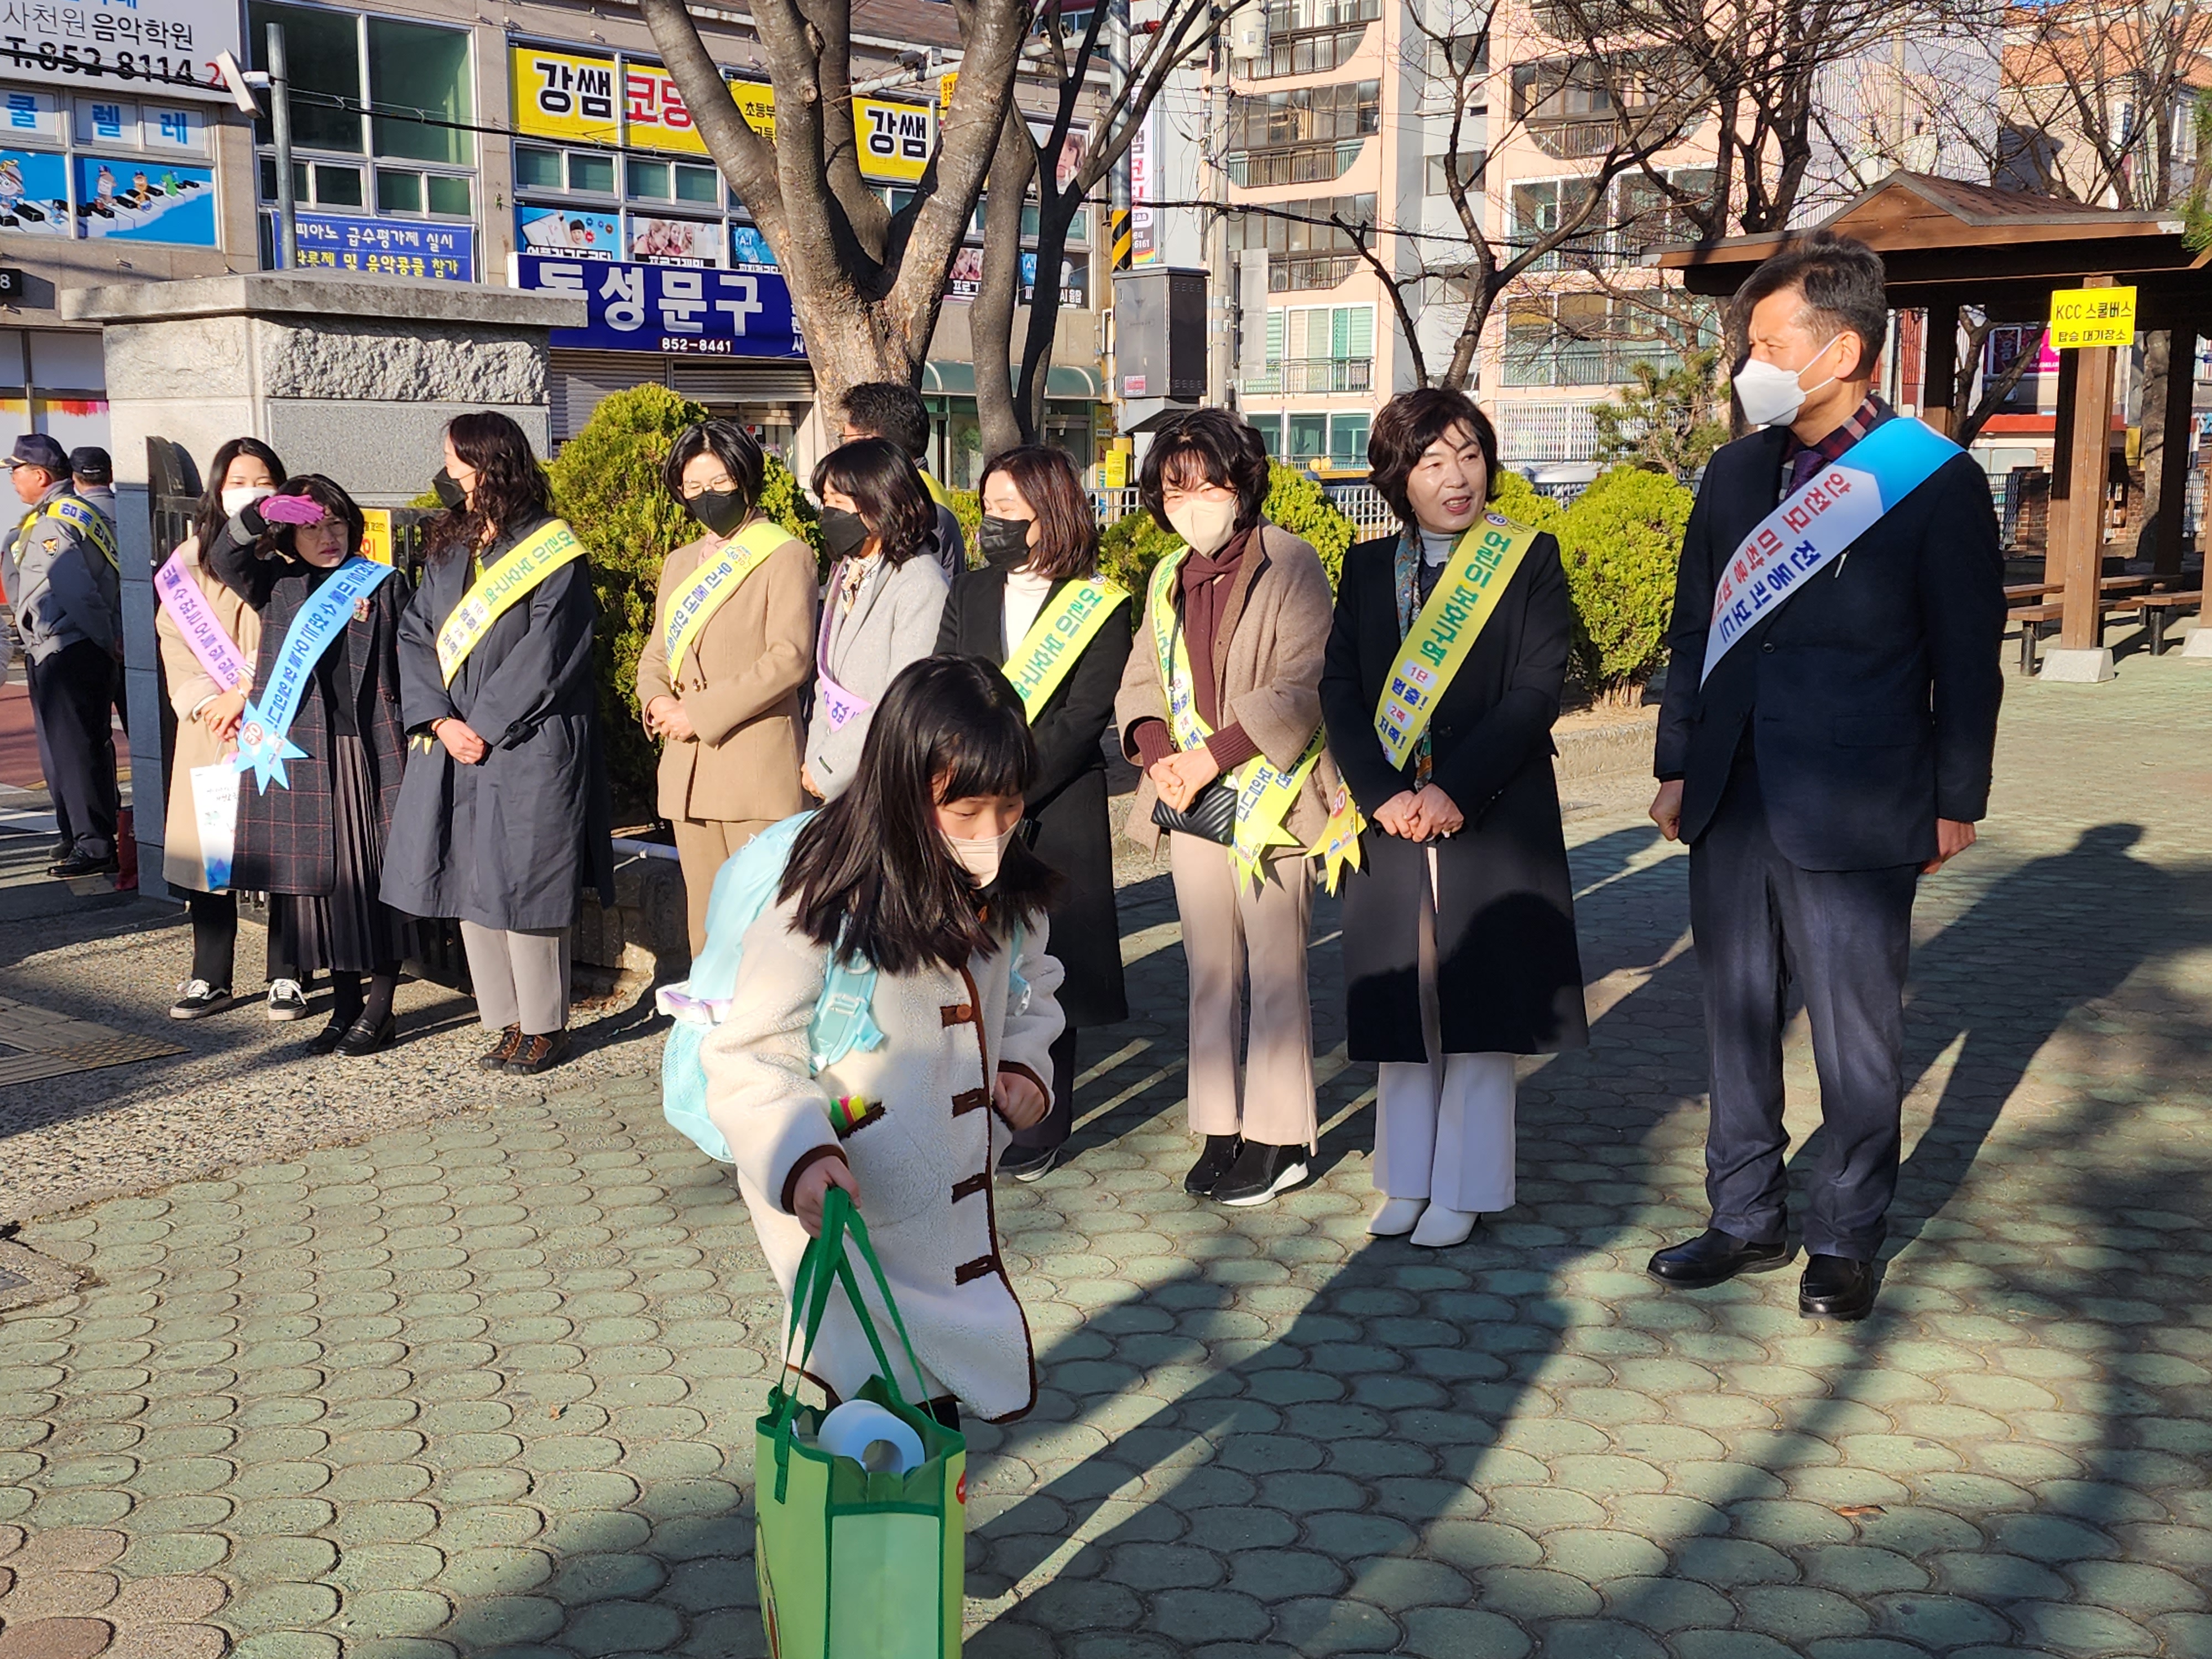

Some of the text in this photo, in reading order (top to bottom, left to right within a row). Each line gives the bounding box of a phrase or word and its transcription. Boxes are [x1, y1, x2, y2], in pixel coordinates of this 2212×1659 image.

[2, 2, 194, 52] 사천원 음악학원
[536, 61, 612, 119] 강쌤
[867, 109, 927, 159] 강쌤
[295, 222, 453, 253] 피아노 급수평가제 실시
[343, 253, 358, 272] 및
[431, 257, 459, 279] 참가
[2056, 301, 2132, 320] KCC 스쿨버스
[661, 337, 732, 353] 852-8441
[2058, 328, 2126, 342] 탑승 대기장소
[1782, 472, 1852, 535] 안전모
[483, 530, 576, 606] 어린이 보호구역
[1420, 531, 1512, 667] 어린이 보호구역
[1719, 539, 1822, 644] 전동킥보드
[1012, 587, 1104, 701] 어린이 보호구역
[1390, 676, 1430, 711] 멈춤!
[244, 723, 263, 745] 30
[1378, 715, 1408, 750] 저쪽!
